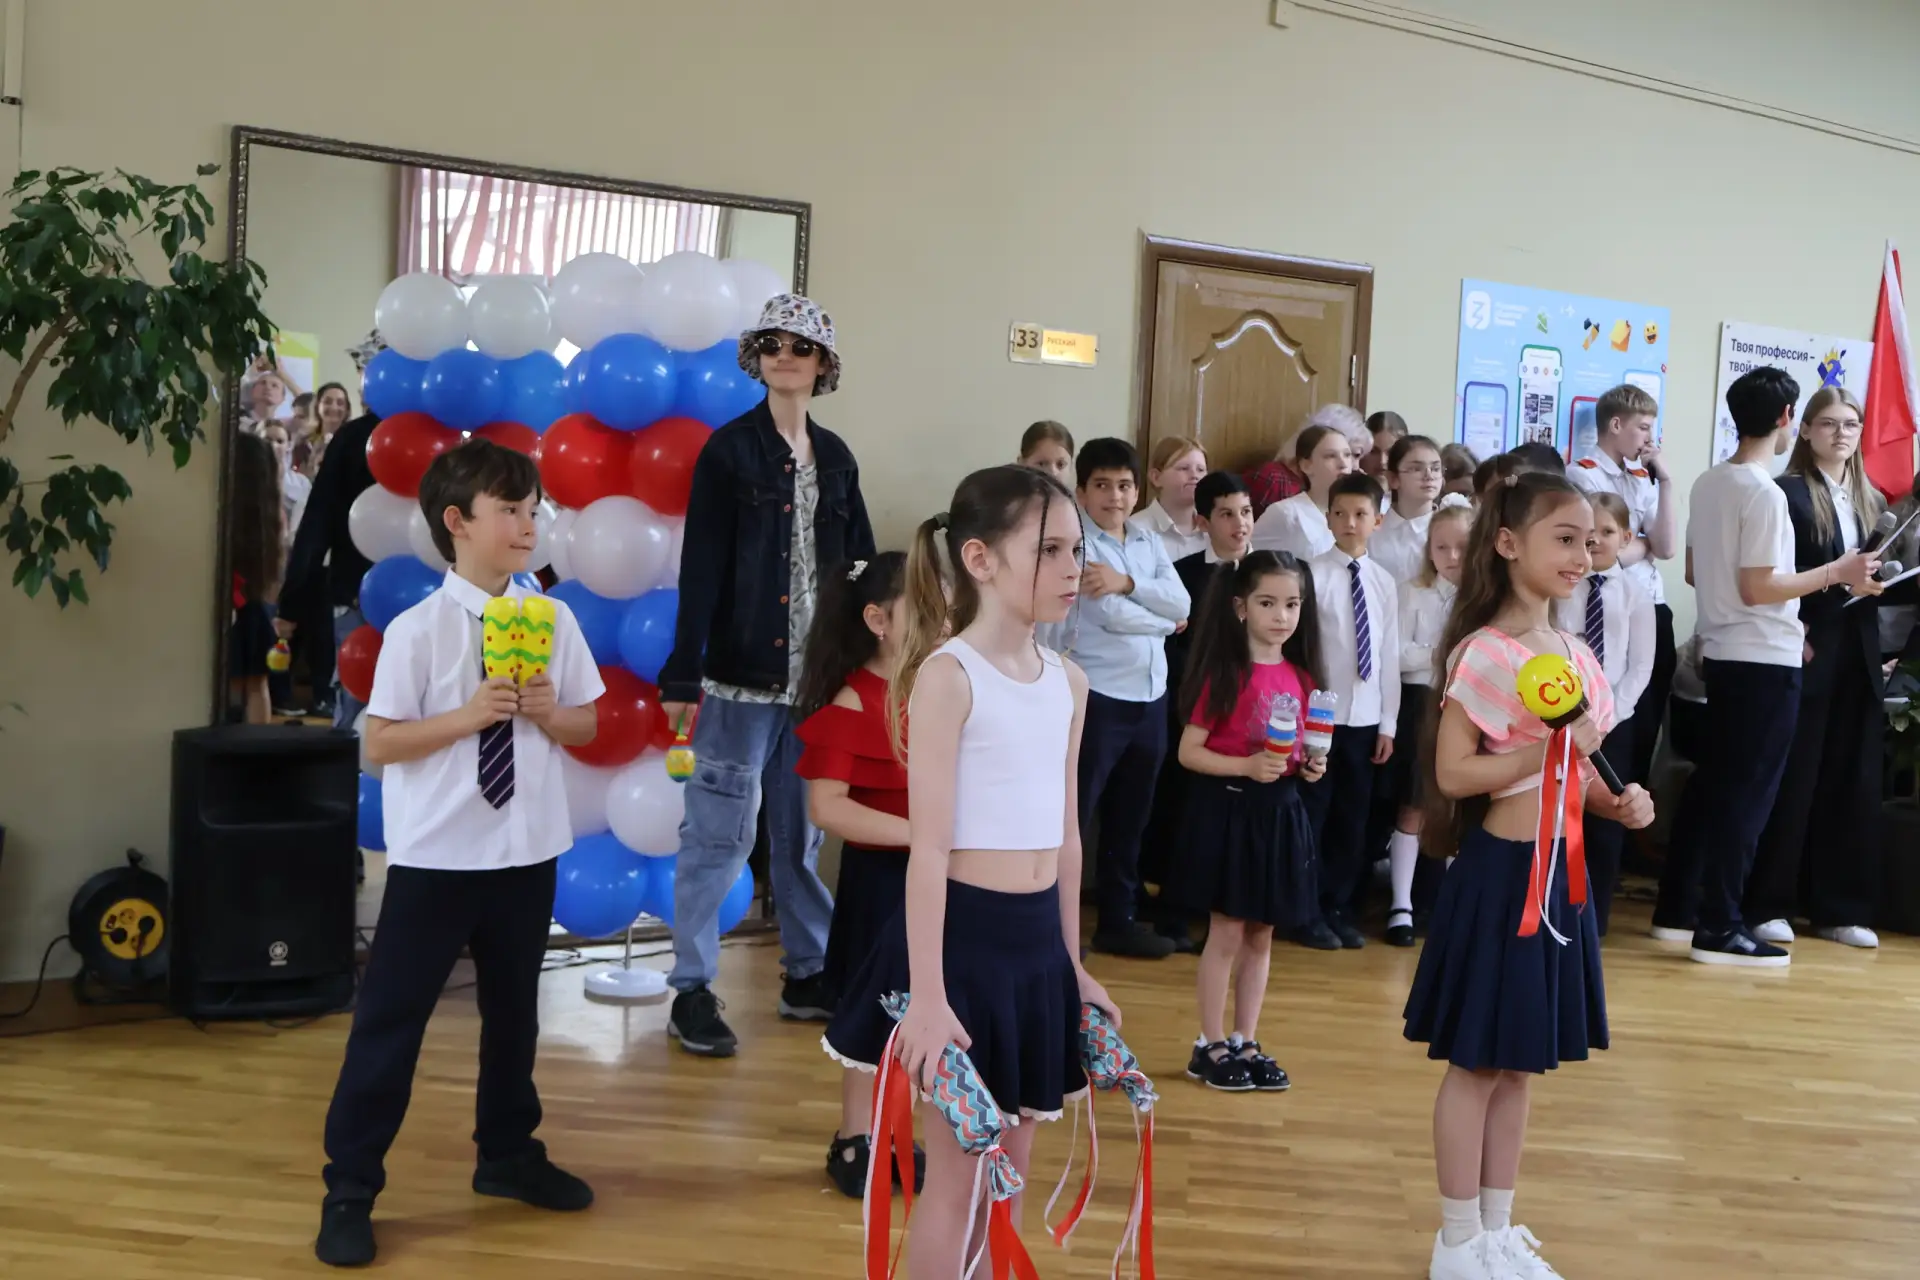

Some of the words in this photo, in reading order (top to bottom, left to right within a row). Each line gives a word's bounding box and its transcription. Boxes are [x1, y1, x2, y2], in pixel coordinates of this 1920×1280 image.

[1016, 328, 1039, 349] 33
[1731, 338, 1754, 354] Твоя
[1755, 344, 1809, 362] профессия
[1729, 360, 1752, 374] твой
